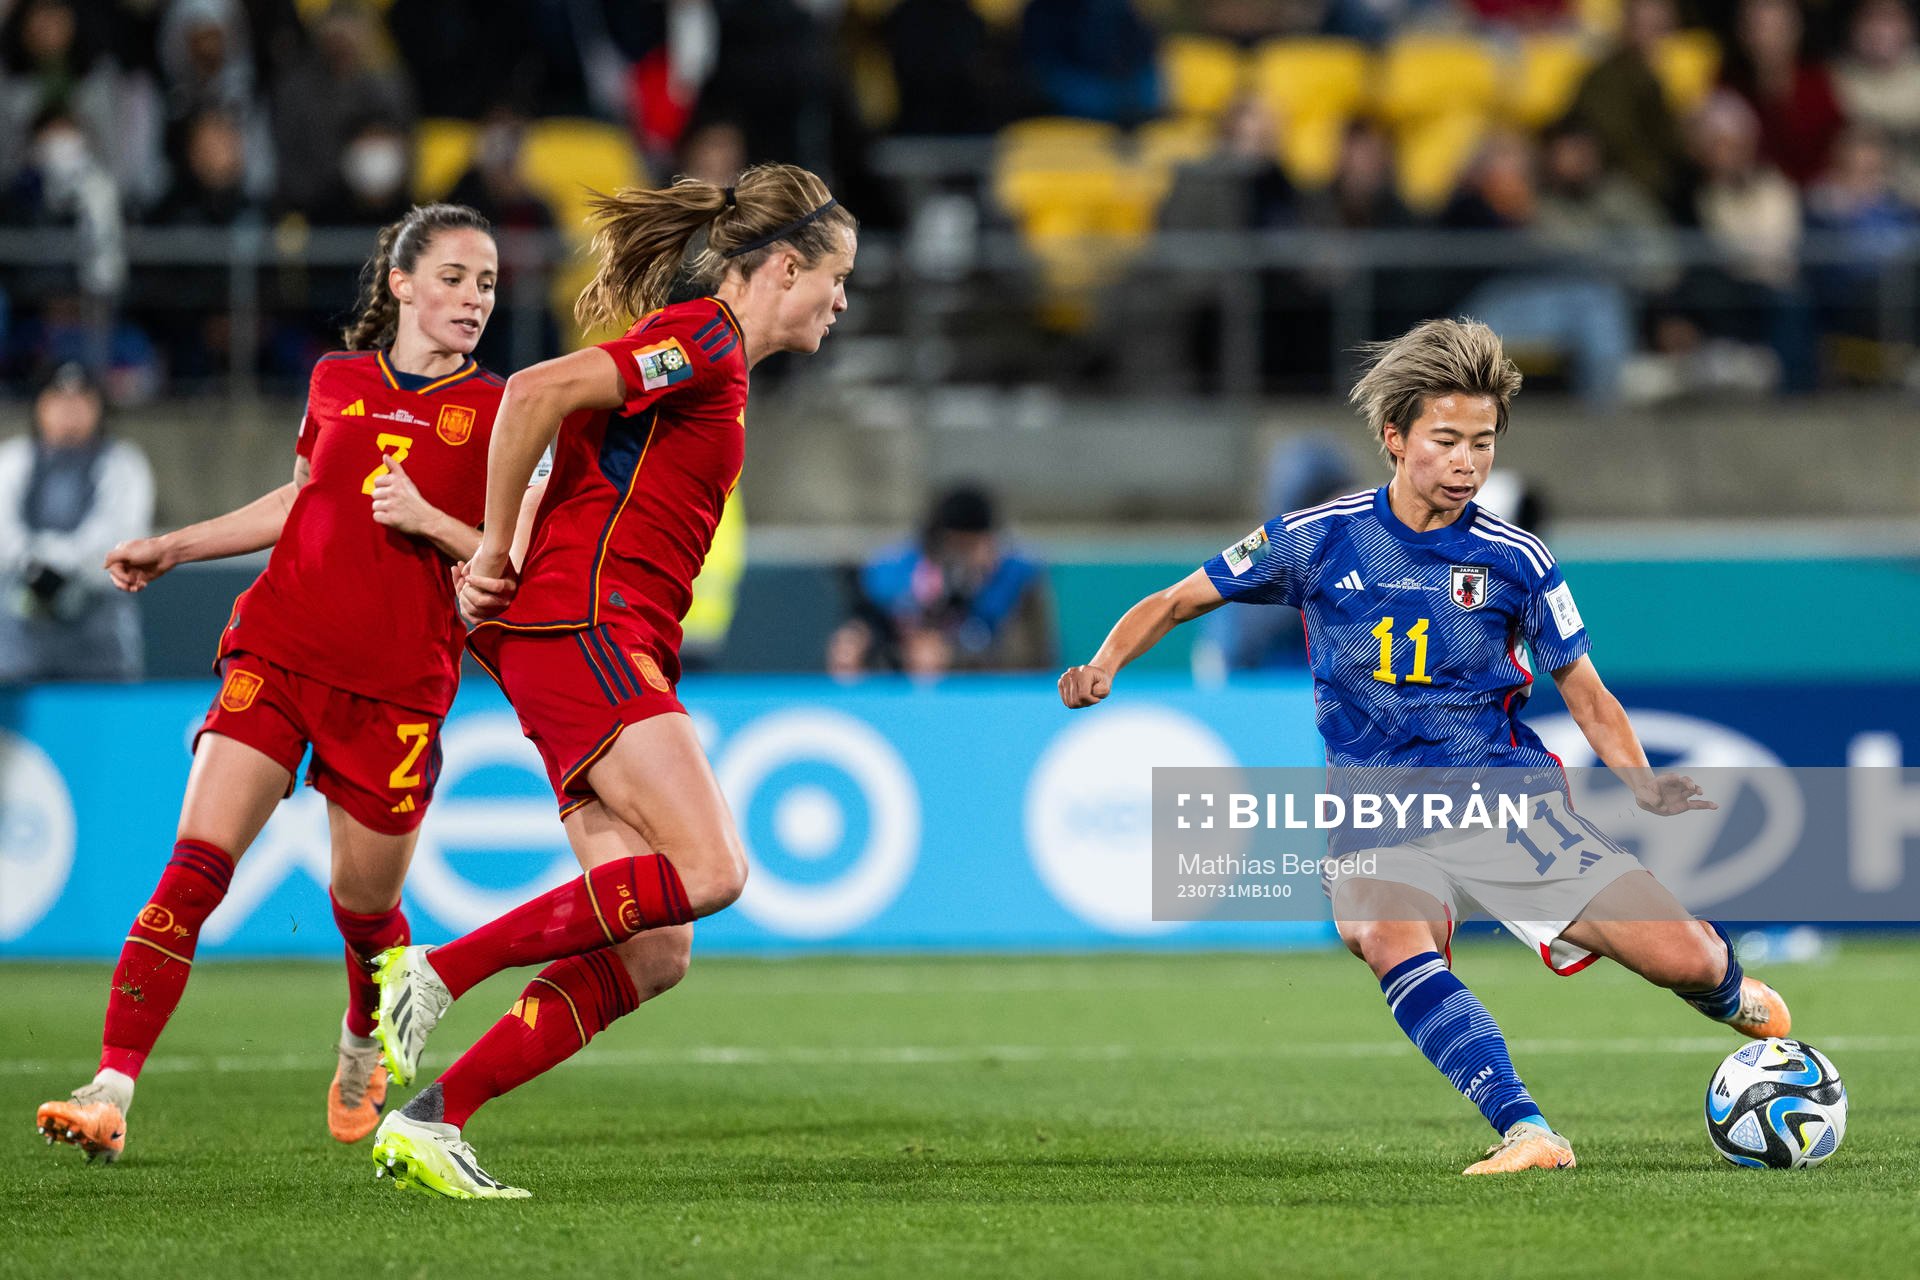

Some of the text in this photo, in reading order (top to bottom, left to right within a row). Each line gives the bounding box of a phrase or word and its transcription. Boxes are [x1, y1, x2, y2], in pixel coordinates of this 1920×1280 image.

[1371, 616, 1433, 685] 11
[389, 723, 430, 789] 2
[1506, 799, 1586, 876] 11
